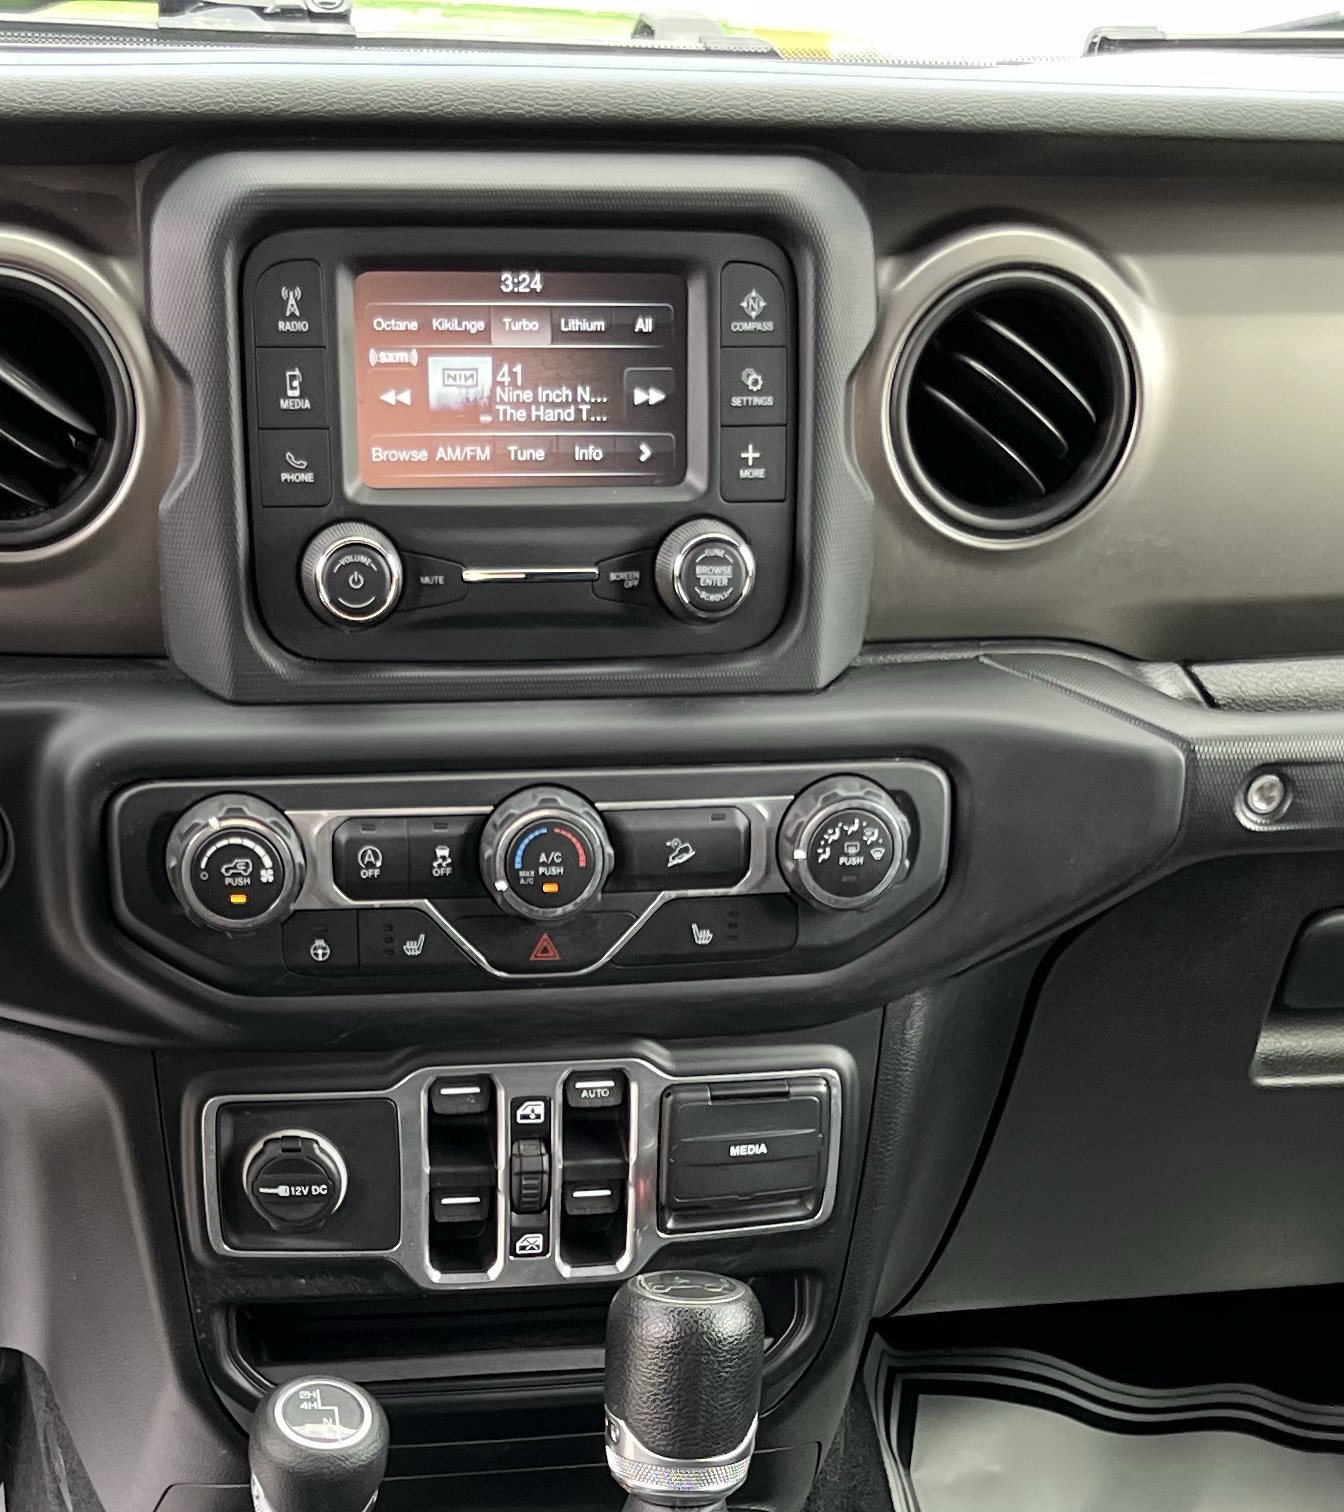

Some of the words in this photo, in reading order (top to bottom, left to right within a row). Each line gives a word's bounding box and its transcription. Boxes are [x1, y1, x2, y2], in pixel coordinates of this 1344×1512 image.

[500, 273, 543, 293] 3:24
[278, 321, 309, 332] RADIO
[373, 318, 418, 331] Octane
[432, 318, 485, 333] KikiLnge
[502, 318, 539, 331] Turbo
[560, 318, 605, 332] Lithium
[634, 318, 653, 333] All
[731, 321, 774, 332] COMPASS
[496, 364, 523, 385] 41
[496, 387, 534, 403] Nine
[538, 386, 573, 403] Inch
[280, 399, 311, 410] MEDIA
[731, 396, 774, 407] SETTINGS
[496, 405, 526, 422] The
[531, 405, 575, 422] Hand
[372, 447, 429, 463] Browse
[436, 446, 491, 462] AM/FM
[508, 446, 545, 461] Tune
[574, 446, 603, 462] Info
[281, 473, 314, 483] PHONE
[739, 469, 766, 479] MORE
[339, 555, 372, 567] VOLUME
[695, 565, 733, 575] BROWSE
[420, 576, 444, 585] MUTE
[699, 577, 729, 587] ENTER
[539, 852, 562, 864] A/C
[839, 856, 864, 866] PUSH
[360, 869, 380, 879] OFF
[432, 867, 452, 877] OFF
[538, 866, 564, 876] PUSH
[224, 877, 251, 887] PUSH
[581, 1088, 609, 1099] AUTO
[729, 1143, 768, 1156] MEDIA
[290, 1186, 309, 1196] 12V
[311, 1184, 328, 1195] DC
[299, 1391, 316, 1399] 2H
[300, 1402, 317, 1410] 4H
